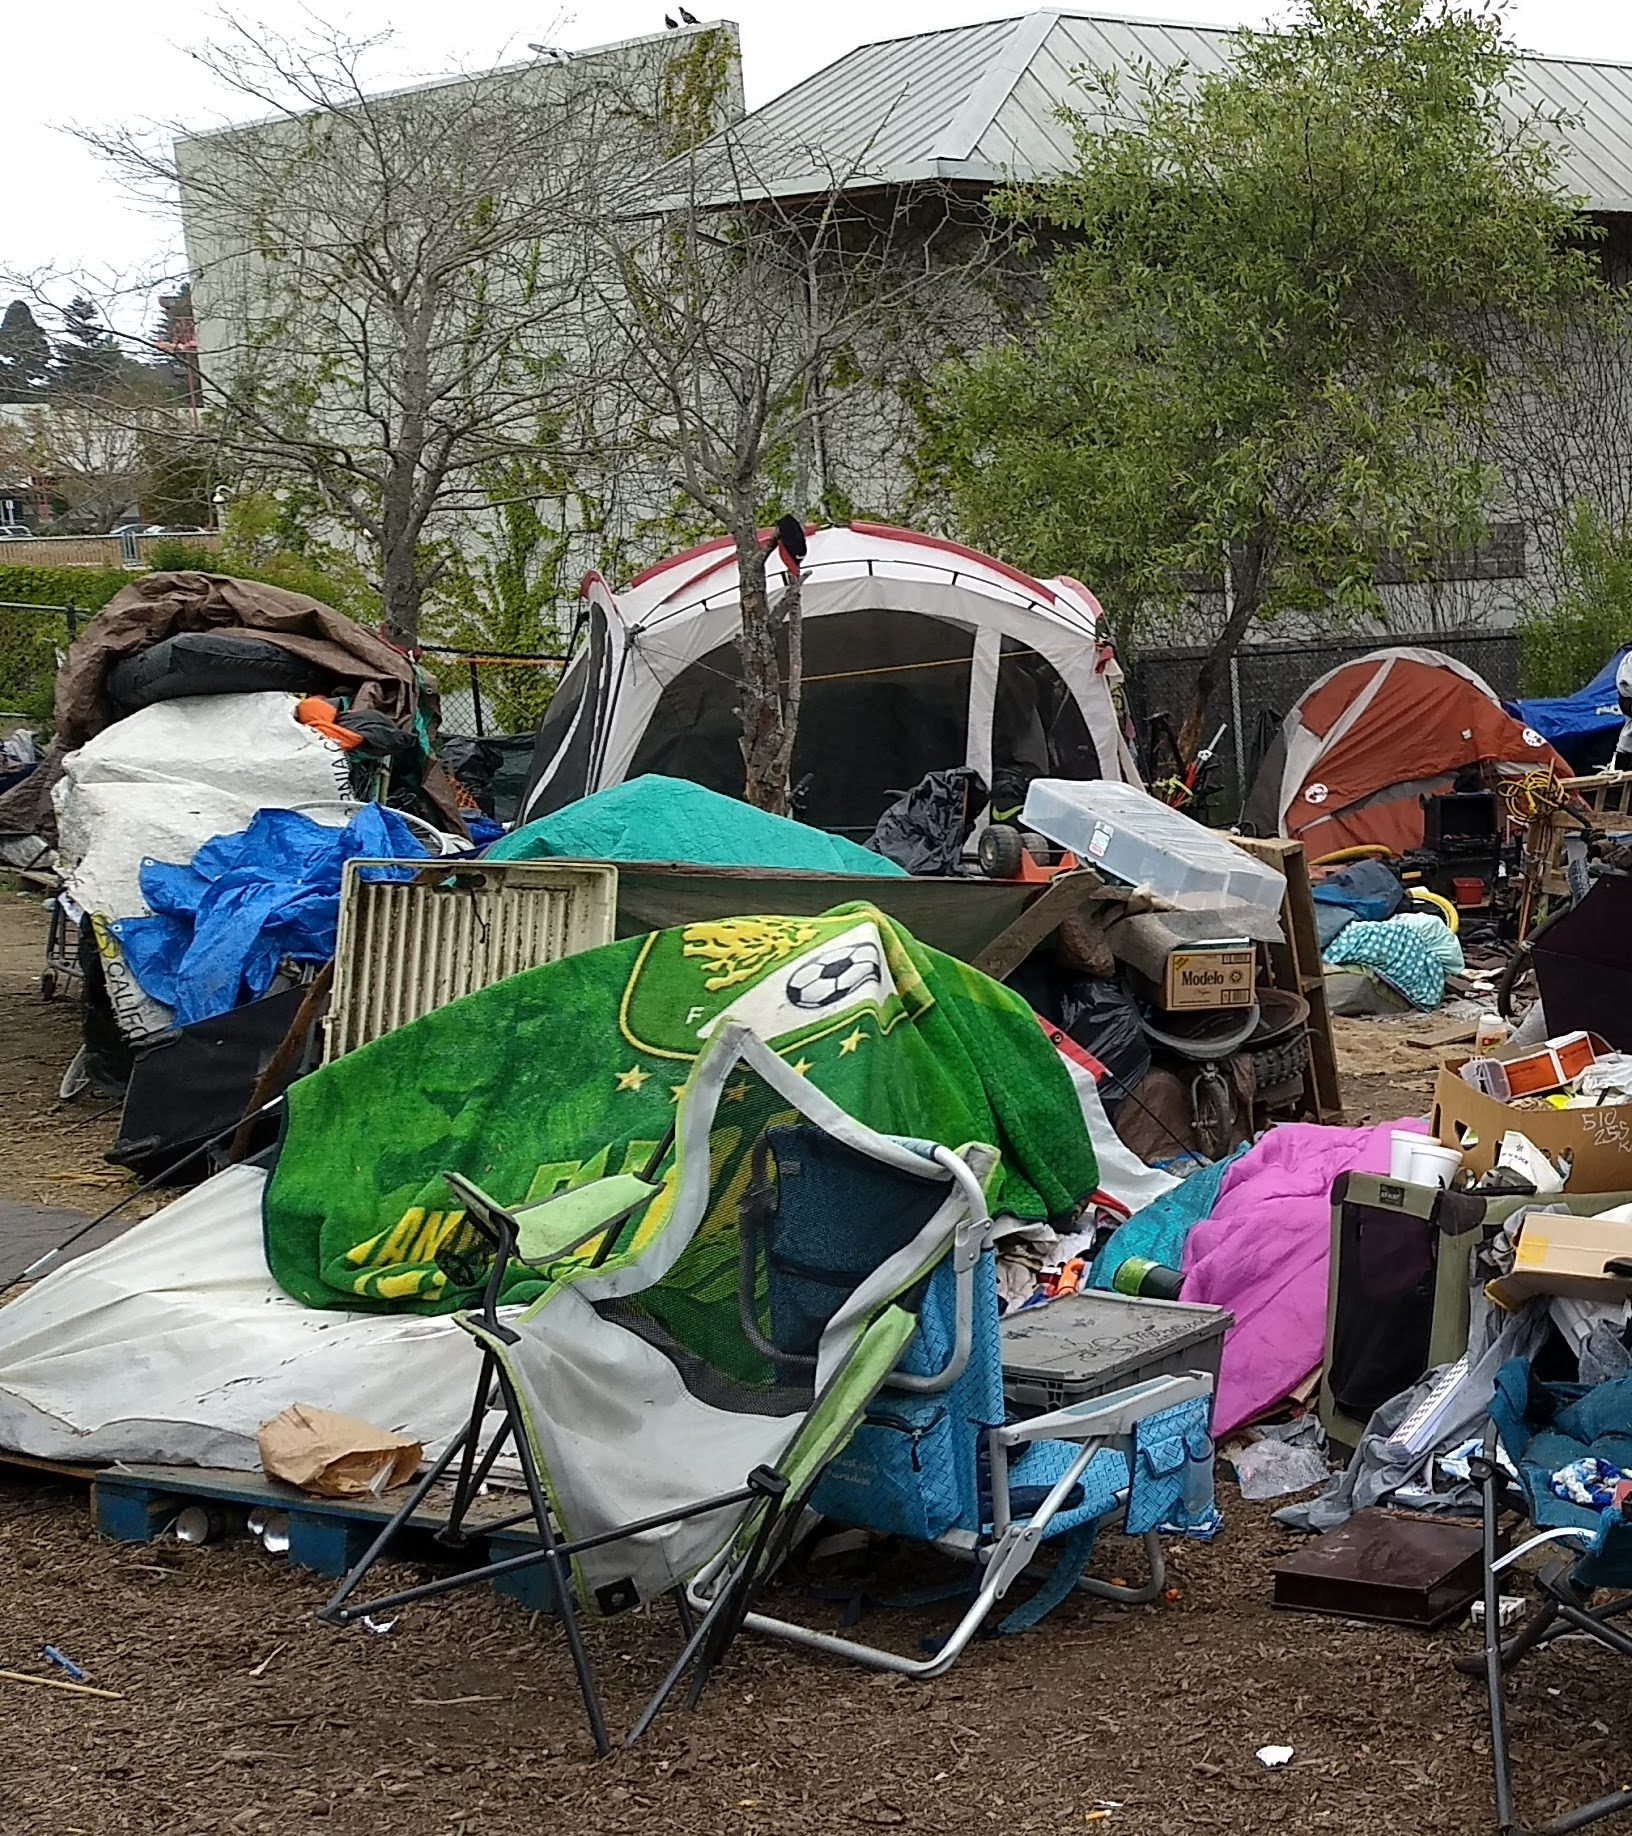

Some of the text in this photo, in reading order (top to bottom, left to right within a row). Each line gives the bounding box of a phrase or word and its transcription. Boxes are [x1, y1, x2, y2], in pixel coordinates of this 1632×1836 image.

[1181, 970, 1225, 986] Modelo
[685, 1006, 705, 1025] F
[1581, 1108, 1618, 1131] 510
